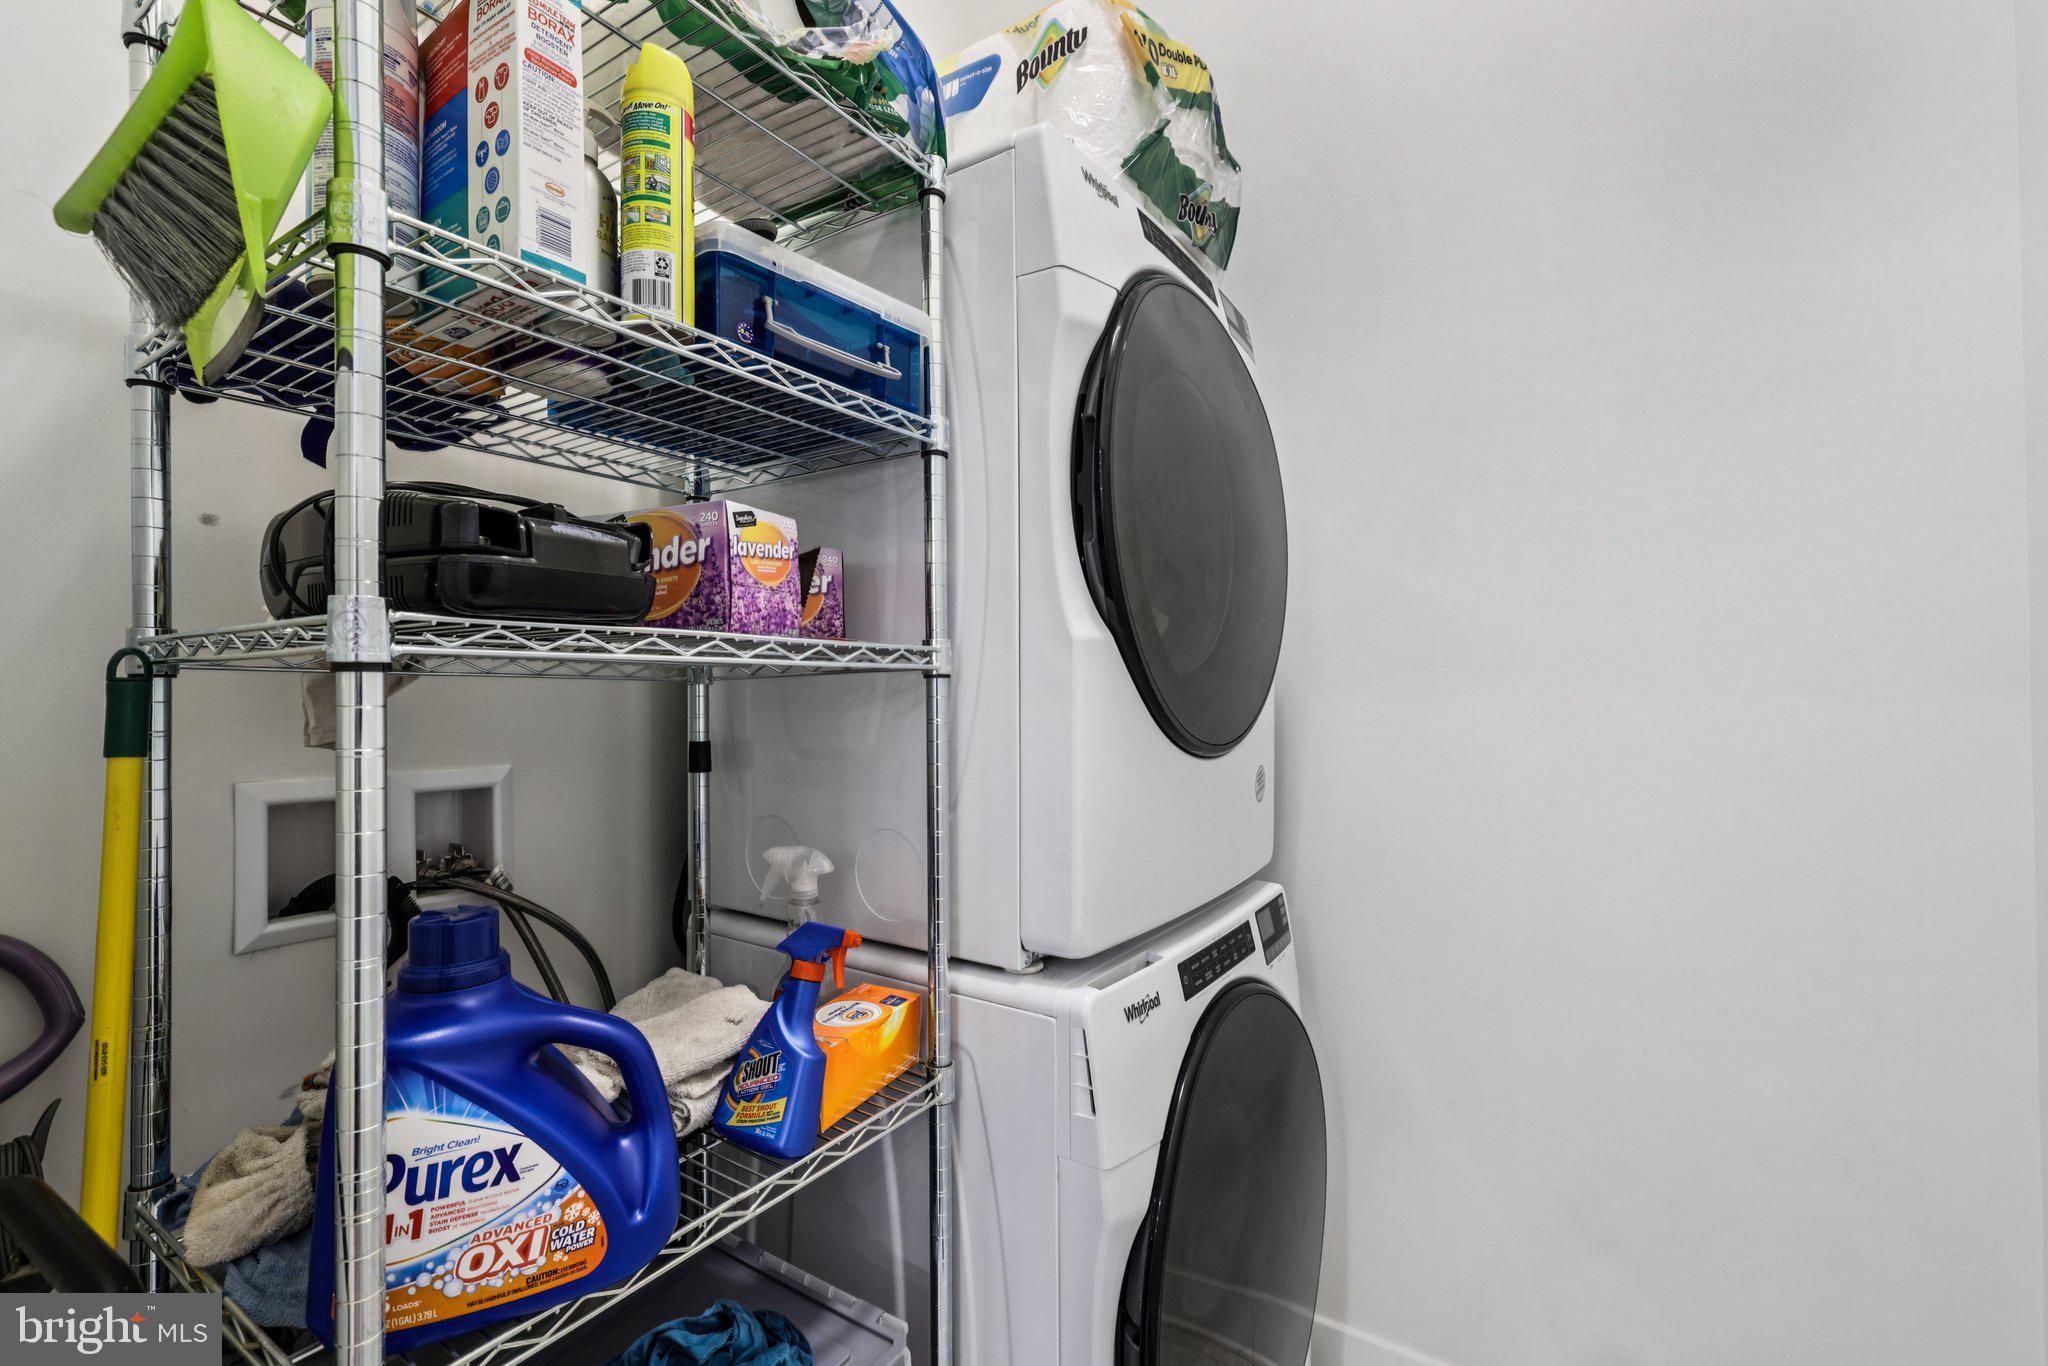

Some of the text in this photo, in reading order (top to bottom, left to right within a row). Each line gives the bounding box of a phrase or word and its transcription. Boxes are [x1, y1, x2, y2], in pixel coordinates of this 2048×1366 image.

[528, 6, 575, 47] BORAX
[531, 22, 572, 52] DETERGENT
[536, 33, 568, 58] BOOSTER
[1158, 43, 1192, 64] Double
[522, 60, 556, 84] CAUTION:
[634, 102, 653, 110] Move
[700, 511, 718, 522] 240
[644, 535, 711, 572] nder
[733, 534, 795, 560] lavender
[822, 556, 838, 564] 240
[1124, 990, 1161, 1024] Whirlpool
[742, 1051, 781, 1082] SHOUT
[756, 1102, 777, 1112] SHOUT
[412, 1134, 481, 1157] Bright Clean!
[430, 1200, 466, 1212] POWERFUL
[430, 1208, 466, 1220] ADVANCED
[428, 1226, 451, 1234] BOOST
[429, 1219, 448, 1228] STAIN
[449, 1212, 478, 1224] DEFENSE
[470, 1213, 553, 1244] ADVANCED
[552, 1220, 586, 1240] COLD
[550, 1226, 596, 1252] WATER
[566, 1238, 594, 1254] POWER
[526, 1268, 560, 1284] CAUTION:
